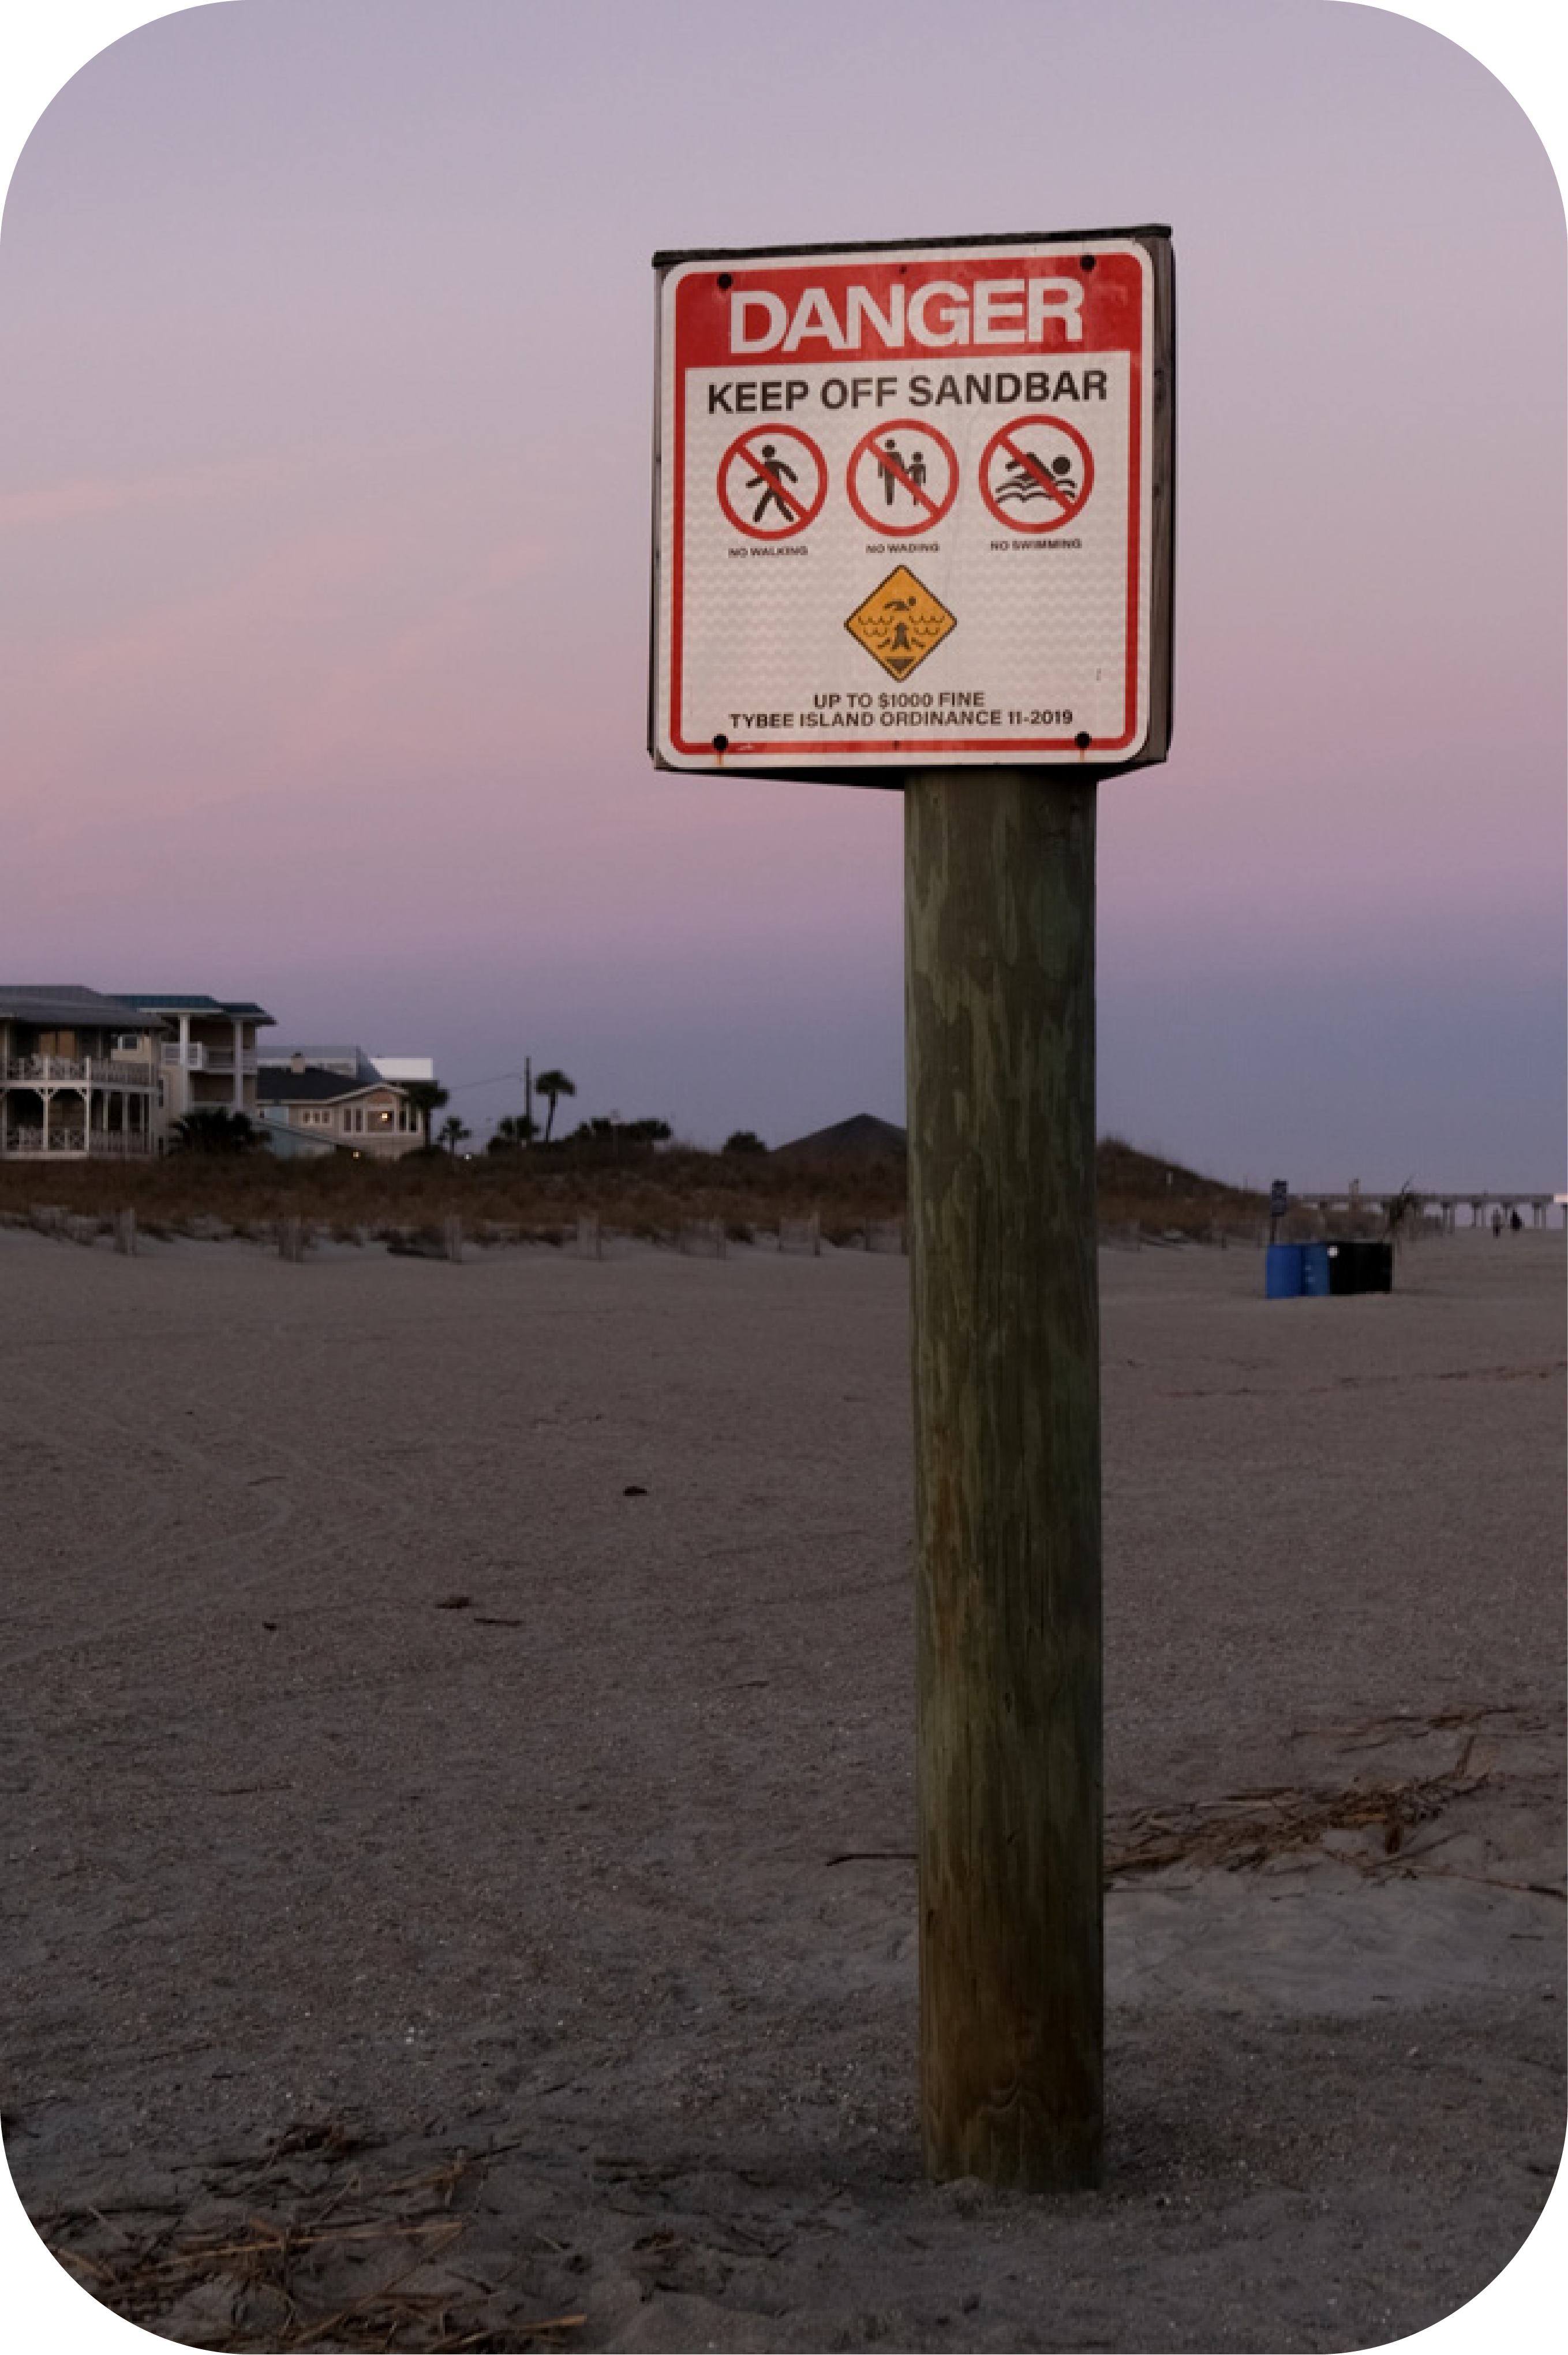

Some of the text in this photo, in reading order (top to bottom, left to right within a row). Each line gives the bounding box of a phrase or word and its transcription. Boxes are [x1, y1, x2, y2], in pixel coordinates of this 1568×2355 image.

[731, 276, 1085, 354] DANGER
[708, 370, 1107, 414] KEEP OFF SANDBAR
[728, 544, 808, 558] NO WALKING
[865, 541, 940, 554] NO WADING
[990, 538, 1082, 551] NO SWIMMING
[813, 690, 986, 709] UP TO $1000 FINE
[728, 709, 1073, 729] TYBEE ISLAND ORDINANCE 11-2019
